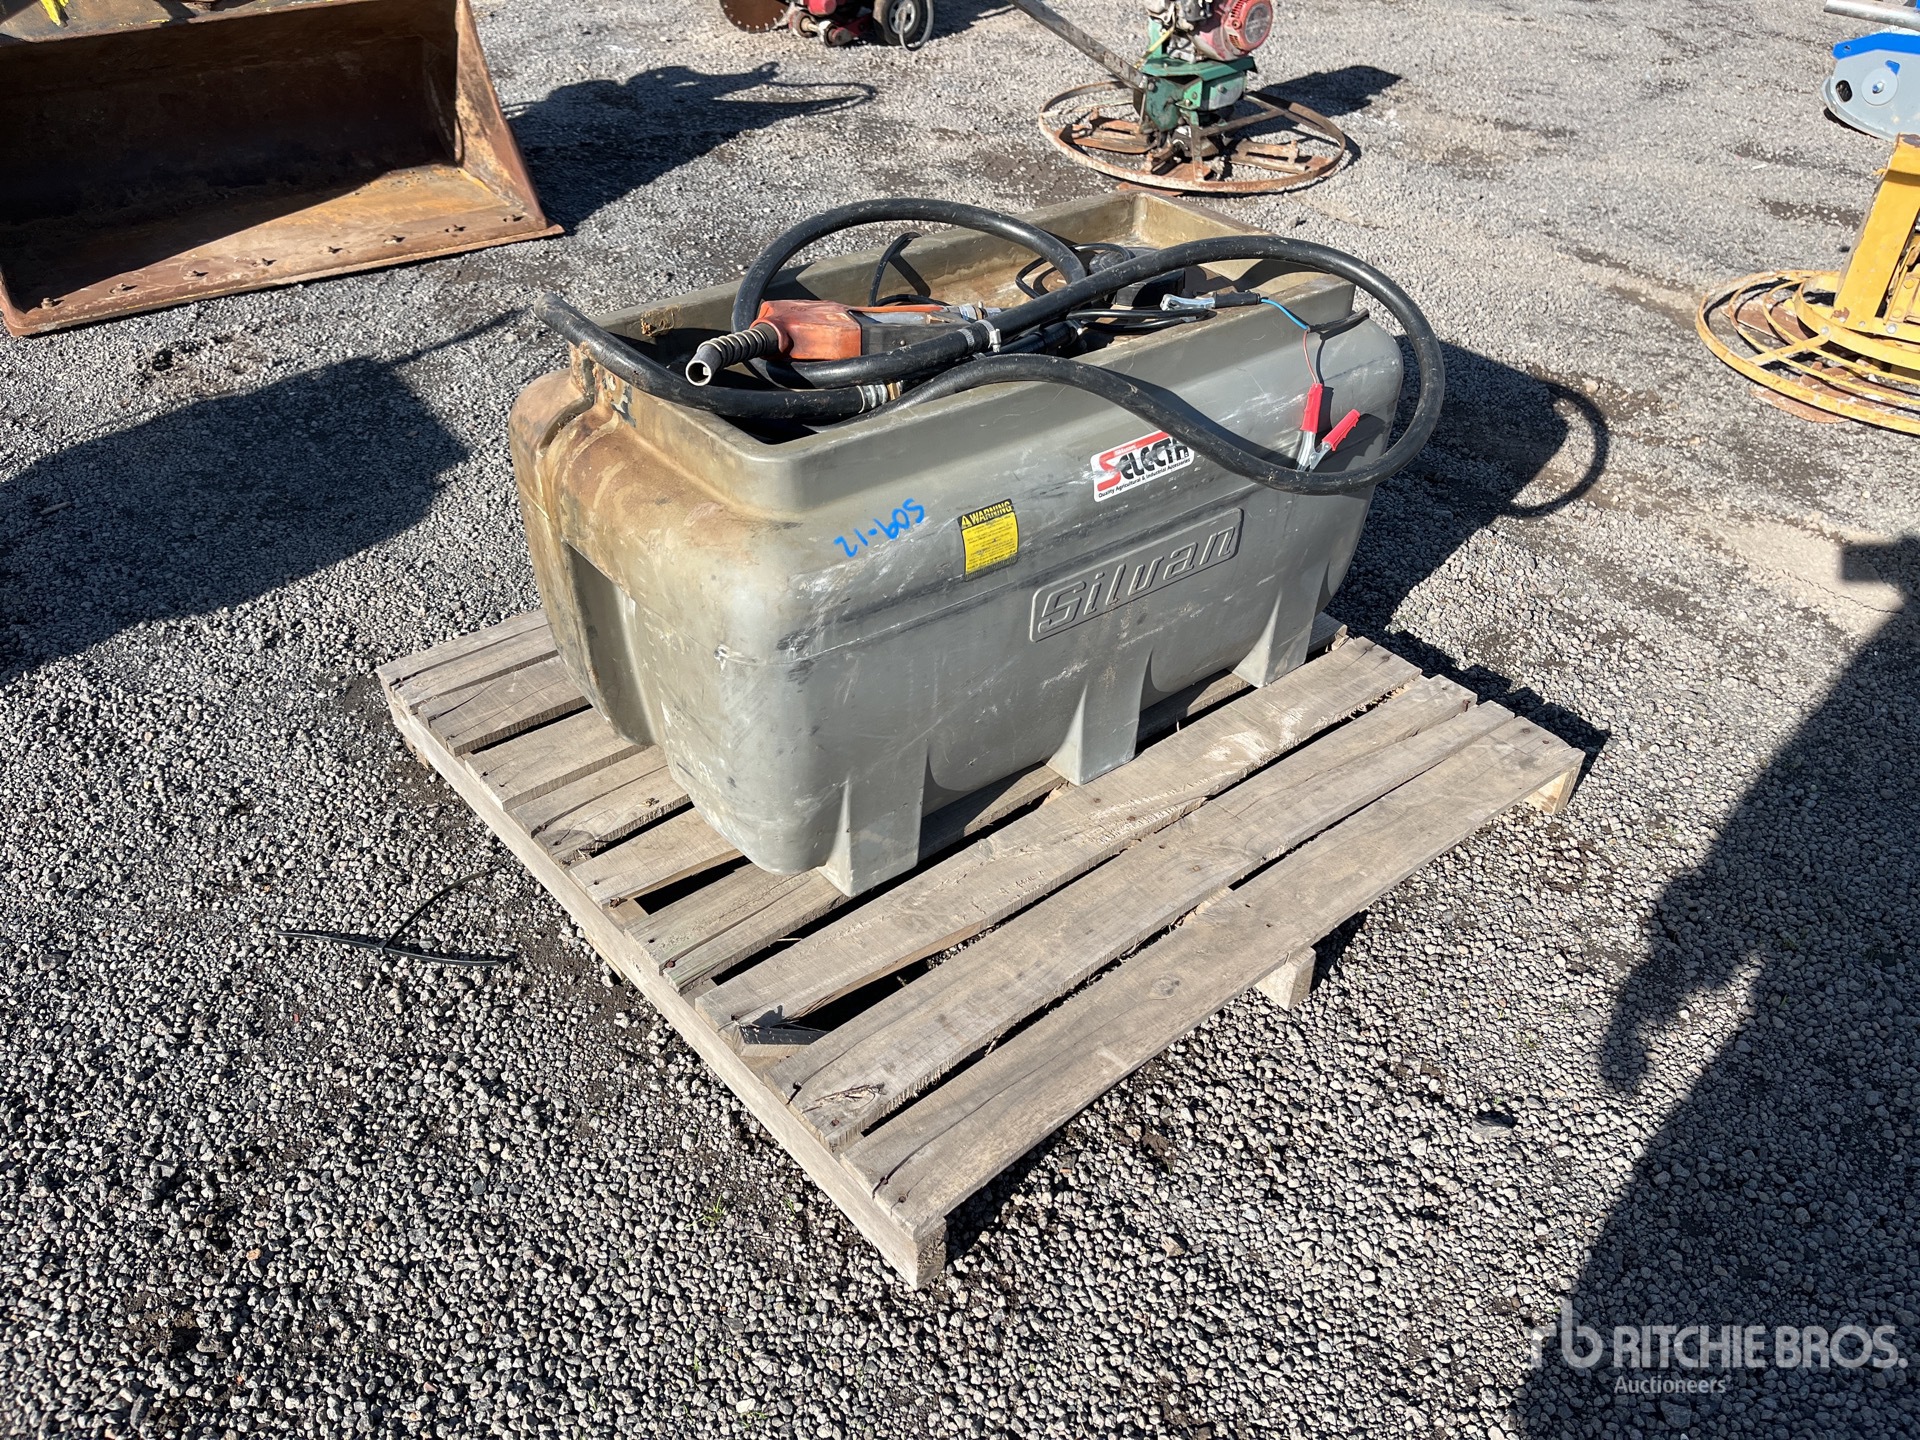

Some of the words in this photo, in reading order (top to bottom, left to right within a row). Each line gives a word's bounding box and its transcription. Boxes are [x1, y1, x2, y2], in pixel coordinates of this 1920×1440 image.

[1098, 488, 1115, 498] Quality
[1115, 476, 1141, 491] Agricultural
[1146, 467, 1167, 480] Industrial
[1167, 457, 1191, 471] Accessories
[969, 500, 1013, 524] WARNING
